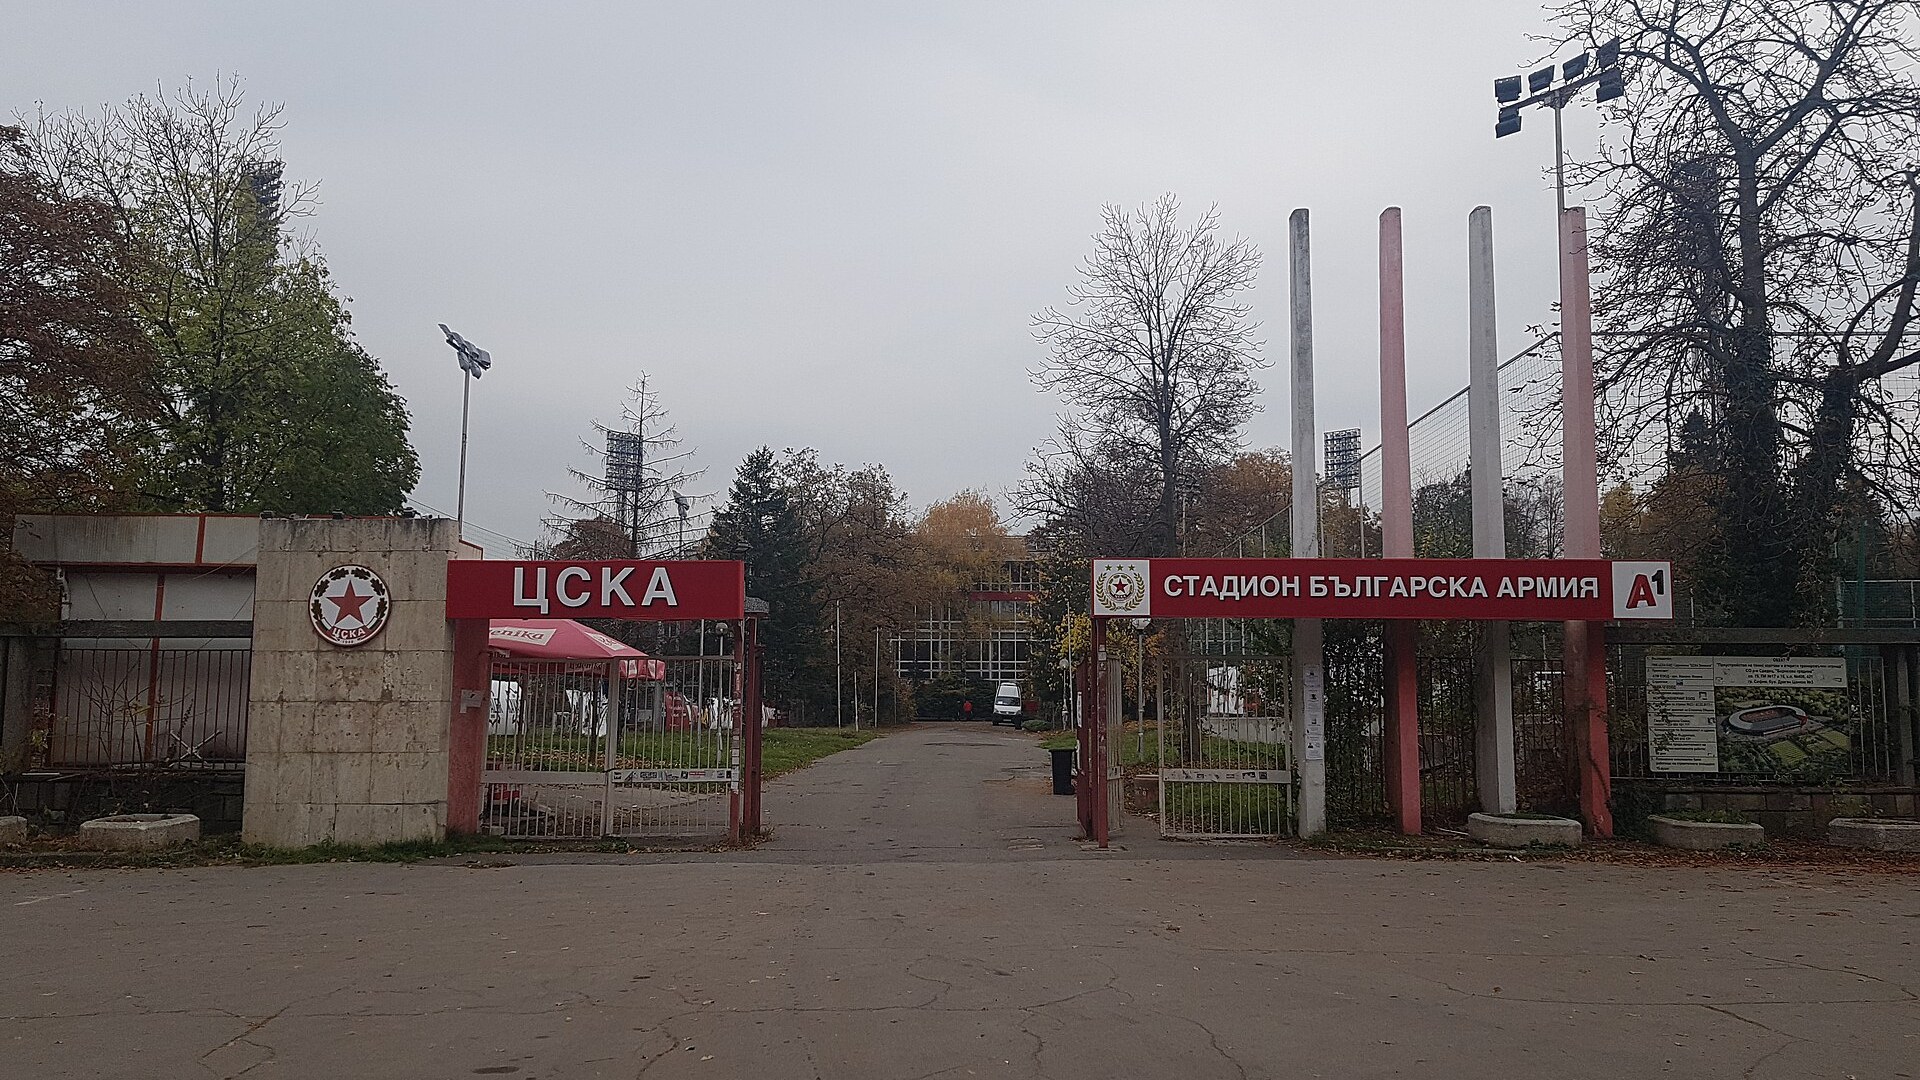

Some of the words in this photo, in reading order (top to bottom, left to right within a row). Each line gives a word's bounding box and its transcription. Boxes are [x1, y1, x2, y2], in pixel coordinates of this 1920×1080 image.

[513, 566, 678, 614] ЦСКА
[1163, 575, 1300, 600] СТАДИОН
[1309, 576, 1489, 598] БЪЛГАРСКА
[1496, 576, 1599, 598] АРМИЯ
[1626, 569, 1664, 609] A1
[332, 628, 366, 639] ЦСКА
[489, 629, 544, 641] enika
